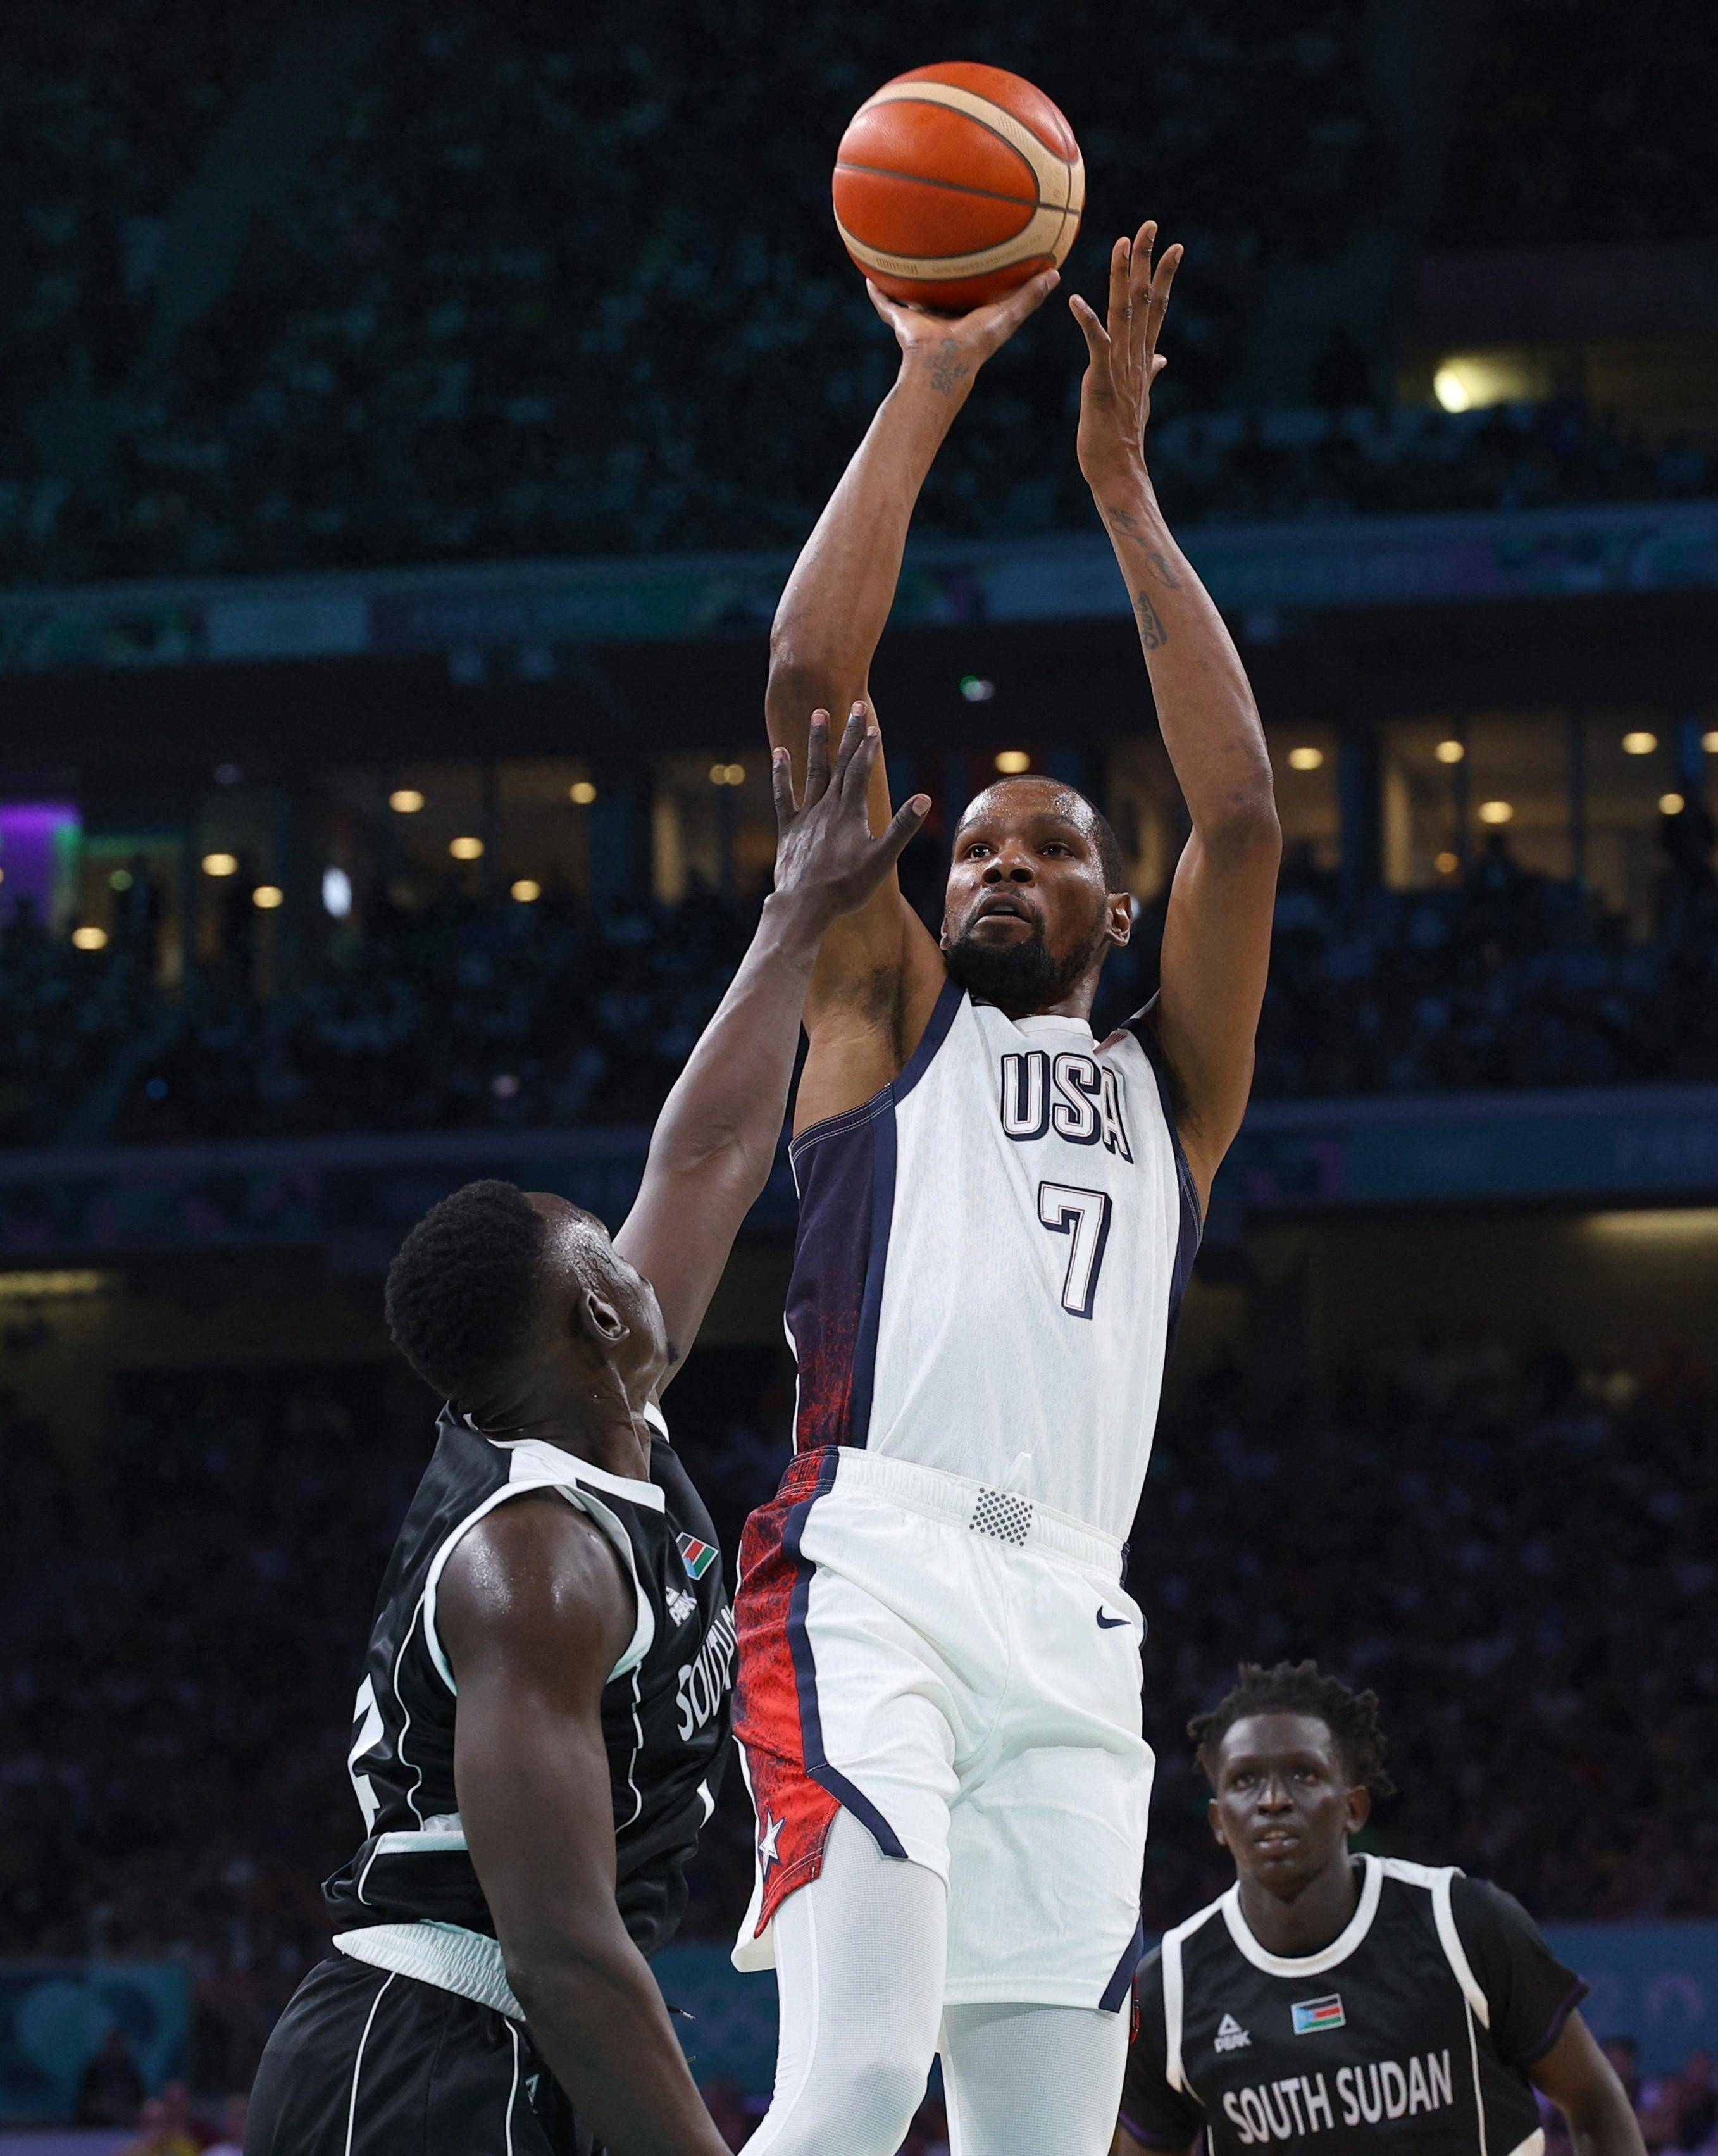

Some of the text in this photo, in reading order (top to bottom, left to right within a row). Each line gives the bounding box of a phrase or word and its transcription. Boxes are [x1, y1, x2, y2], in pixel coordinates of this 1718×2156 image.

[1001, 1050, 1133, 1164] USA
[1038, 1181, 1112, 1320] 7
[1223, 2048, 1454, 2145] SOUTH SUDAN
